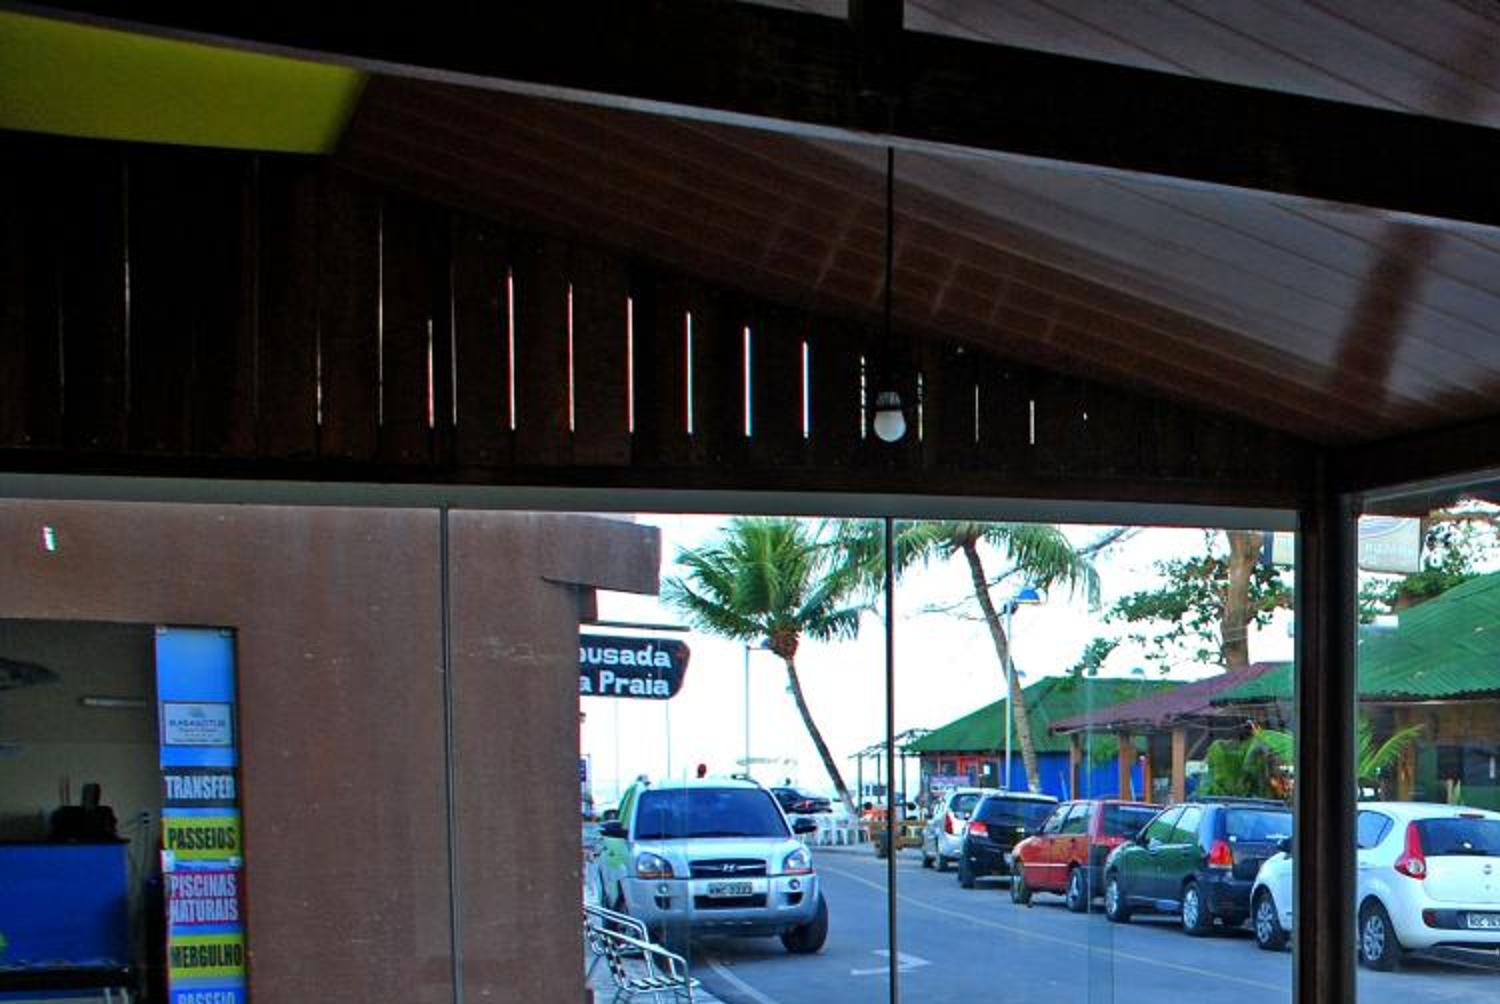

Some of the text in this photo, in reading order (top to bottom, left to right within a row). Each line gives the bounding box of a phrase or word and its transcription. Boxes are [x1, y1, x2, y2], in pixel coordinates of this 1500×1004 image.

[599, 669, 669, 696] Praia
[164, 775, 235, 799] TRANSFER
[167, 826, 236, 849] PASSEIOS
[170, 874, 237, 897] PISCINAS
[170, 898, 239, 922] NATURAIS
[171, 944, 242, 968] MERGULHO
